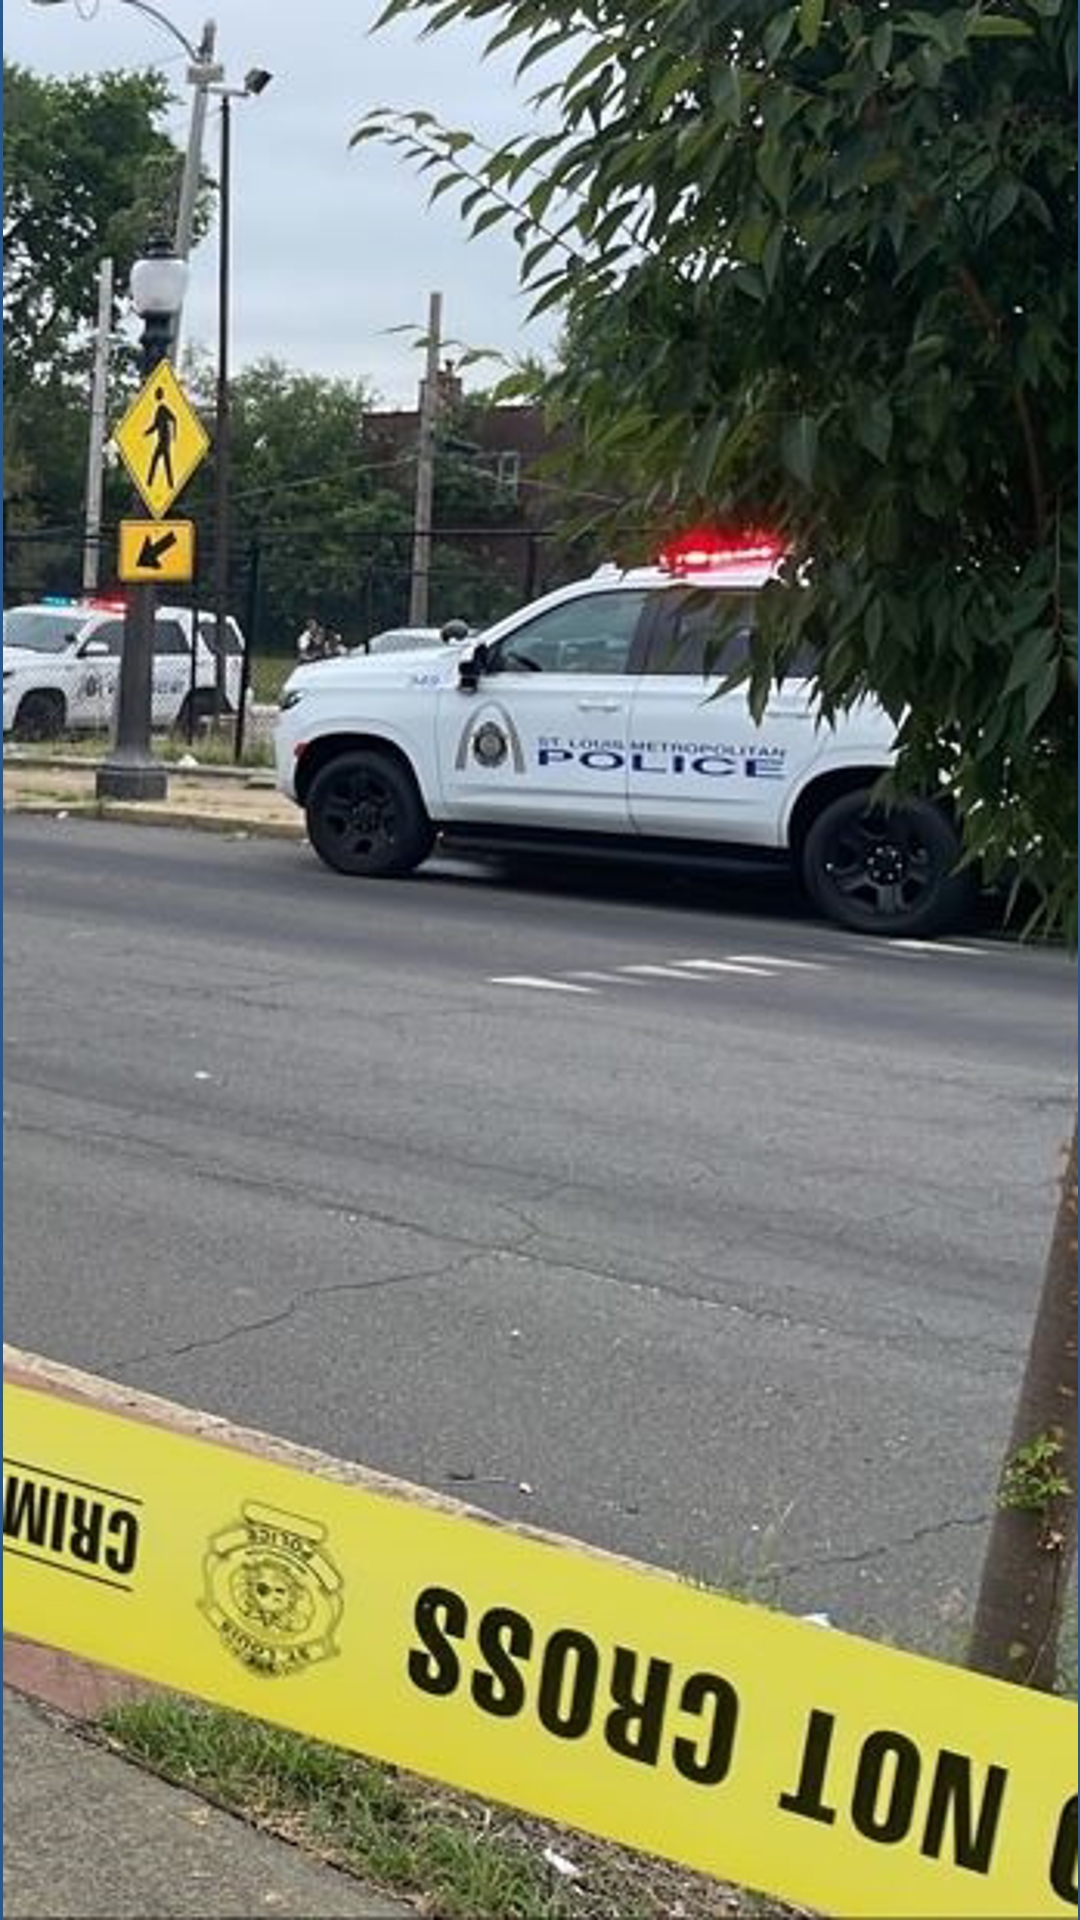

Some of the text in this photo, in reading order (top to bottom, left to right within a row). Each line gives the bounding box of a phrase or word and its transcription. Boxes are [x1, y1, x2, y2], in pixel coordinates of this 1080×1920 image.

[538, 749, 784, 778] POLICE
[568, 738, 625, 750] LOUIS
[630, 741, 785, 758] METROPOLITAN
[407, 1587, 739, 1786] CROSS
[779, 1709, 1008, 1874] NOT
